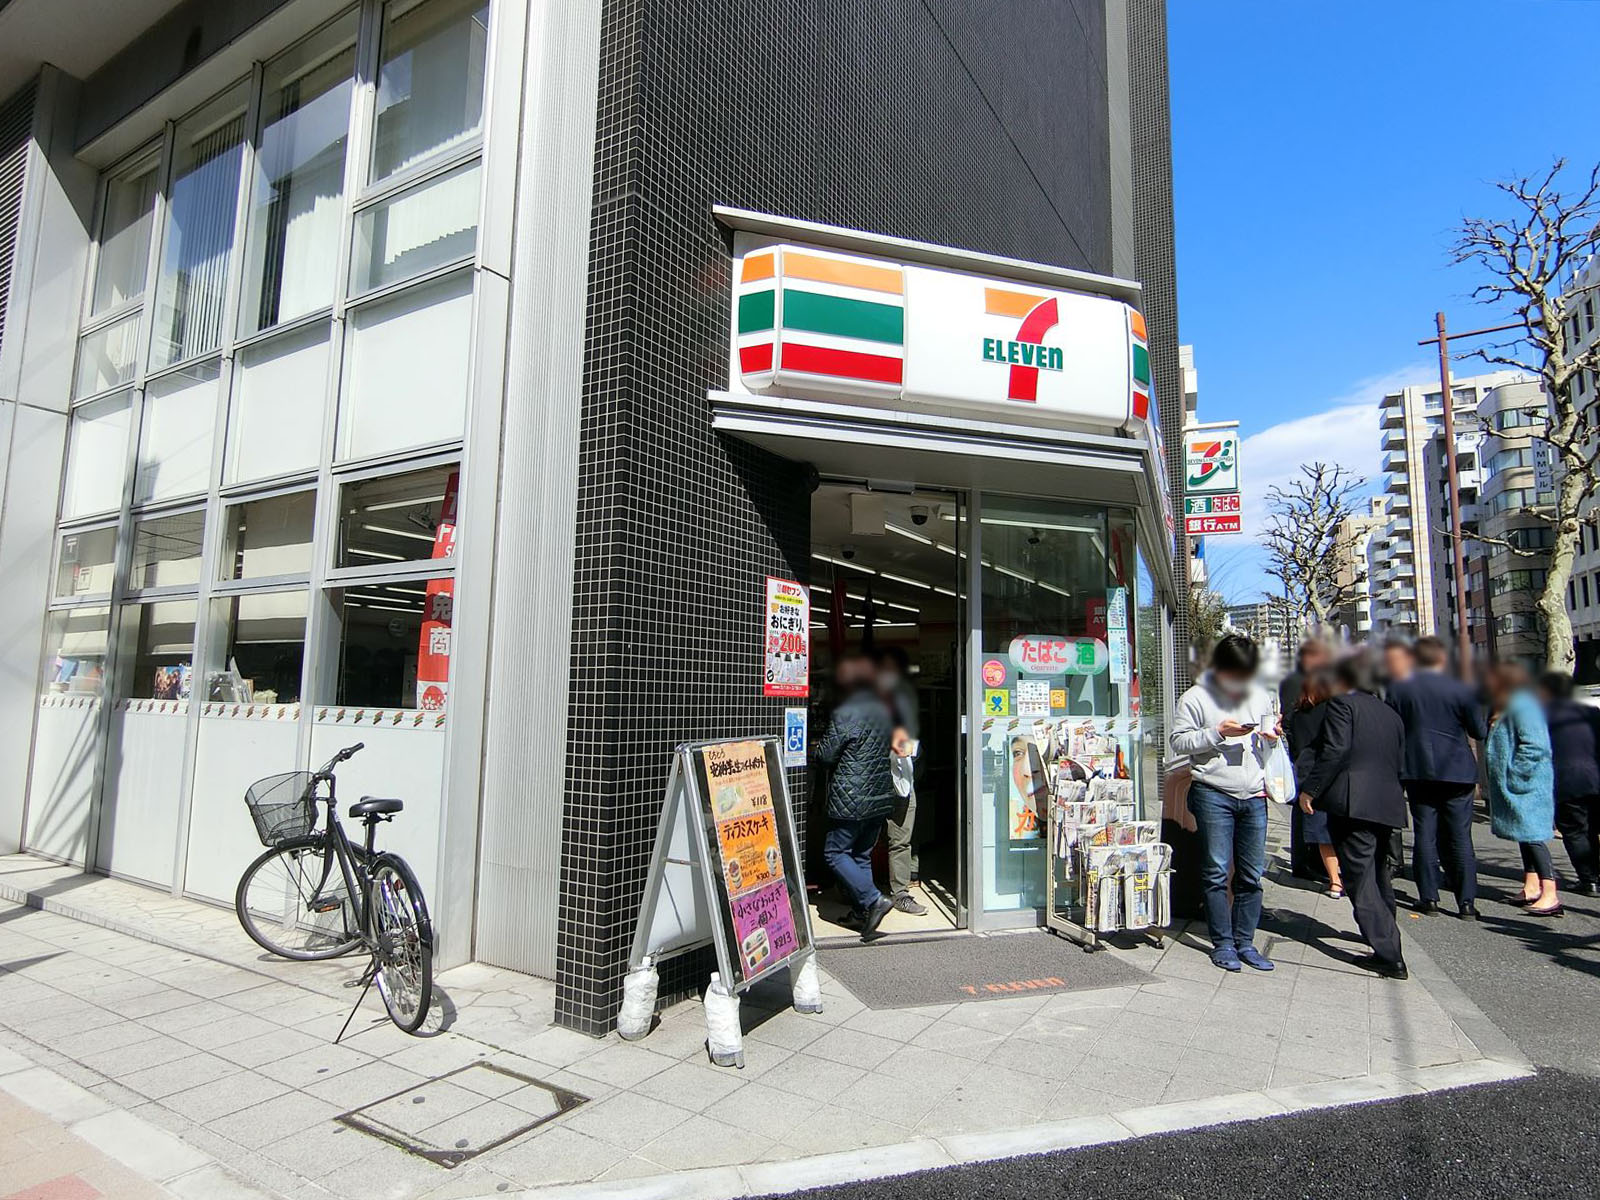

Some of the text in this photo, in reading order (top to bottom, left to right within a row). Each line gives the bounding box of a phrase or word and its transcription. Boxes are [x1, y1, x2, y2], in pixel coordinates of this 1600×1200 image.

[1190, 497, 1239, 514] 酒 たばこ
[1021, 640, 1067, 663] たばこ
[723, 815, 769, 841] ティラミスケーキ
